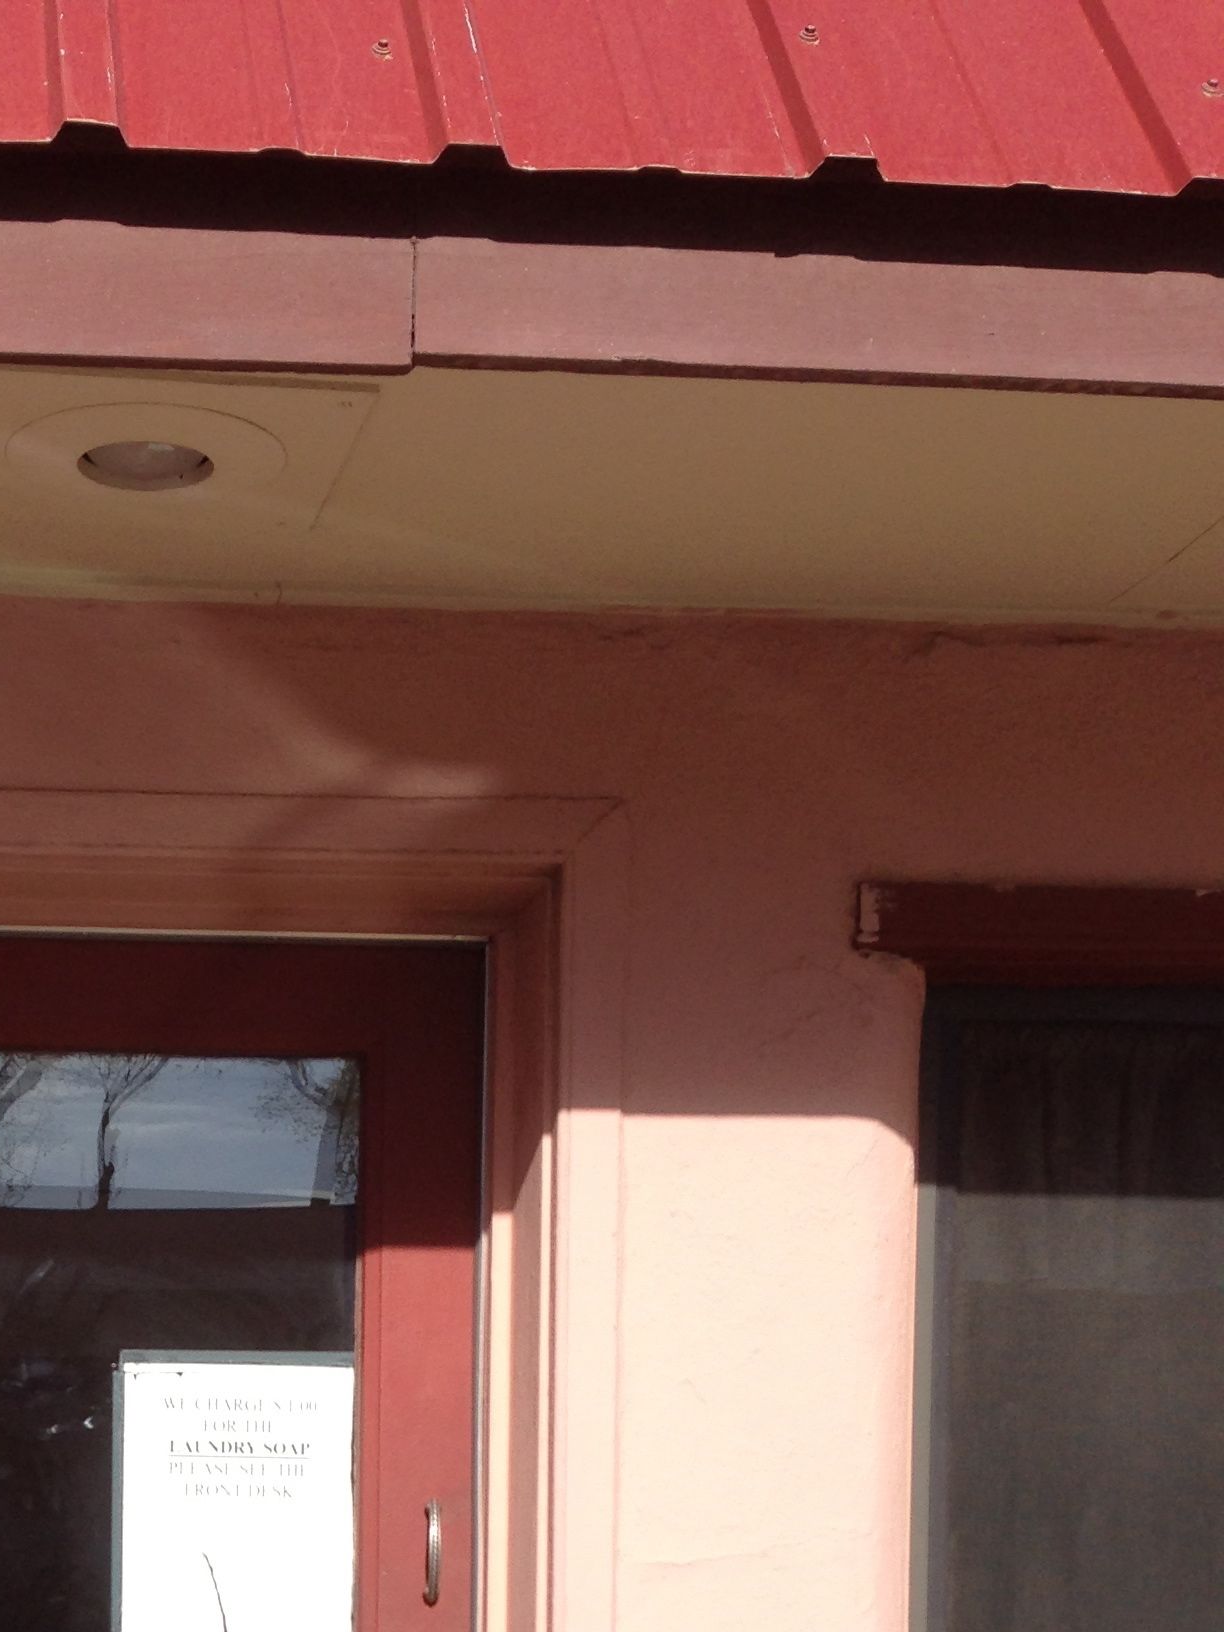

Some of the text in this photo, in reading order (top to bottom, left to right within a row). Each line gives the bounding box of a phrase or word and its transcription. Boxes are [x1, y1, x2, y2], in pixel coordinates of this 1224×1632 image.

[203, 1419, 237, 1433] FOR
[169, 1440, 311, 1455] LAUNDRY SOAP
[184, 1483, 242, 1497] FRONT
